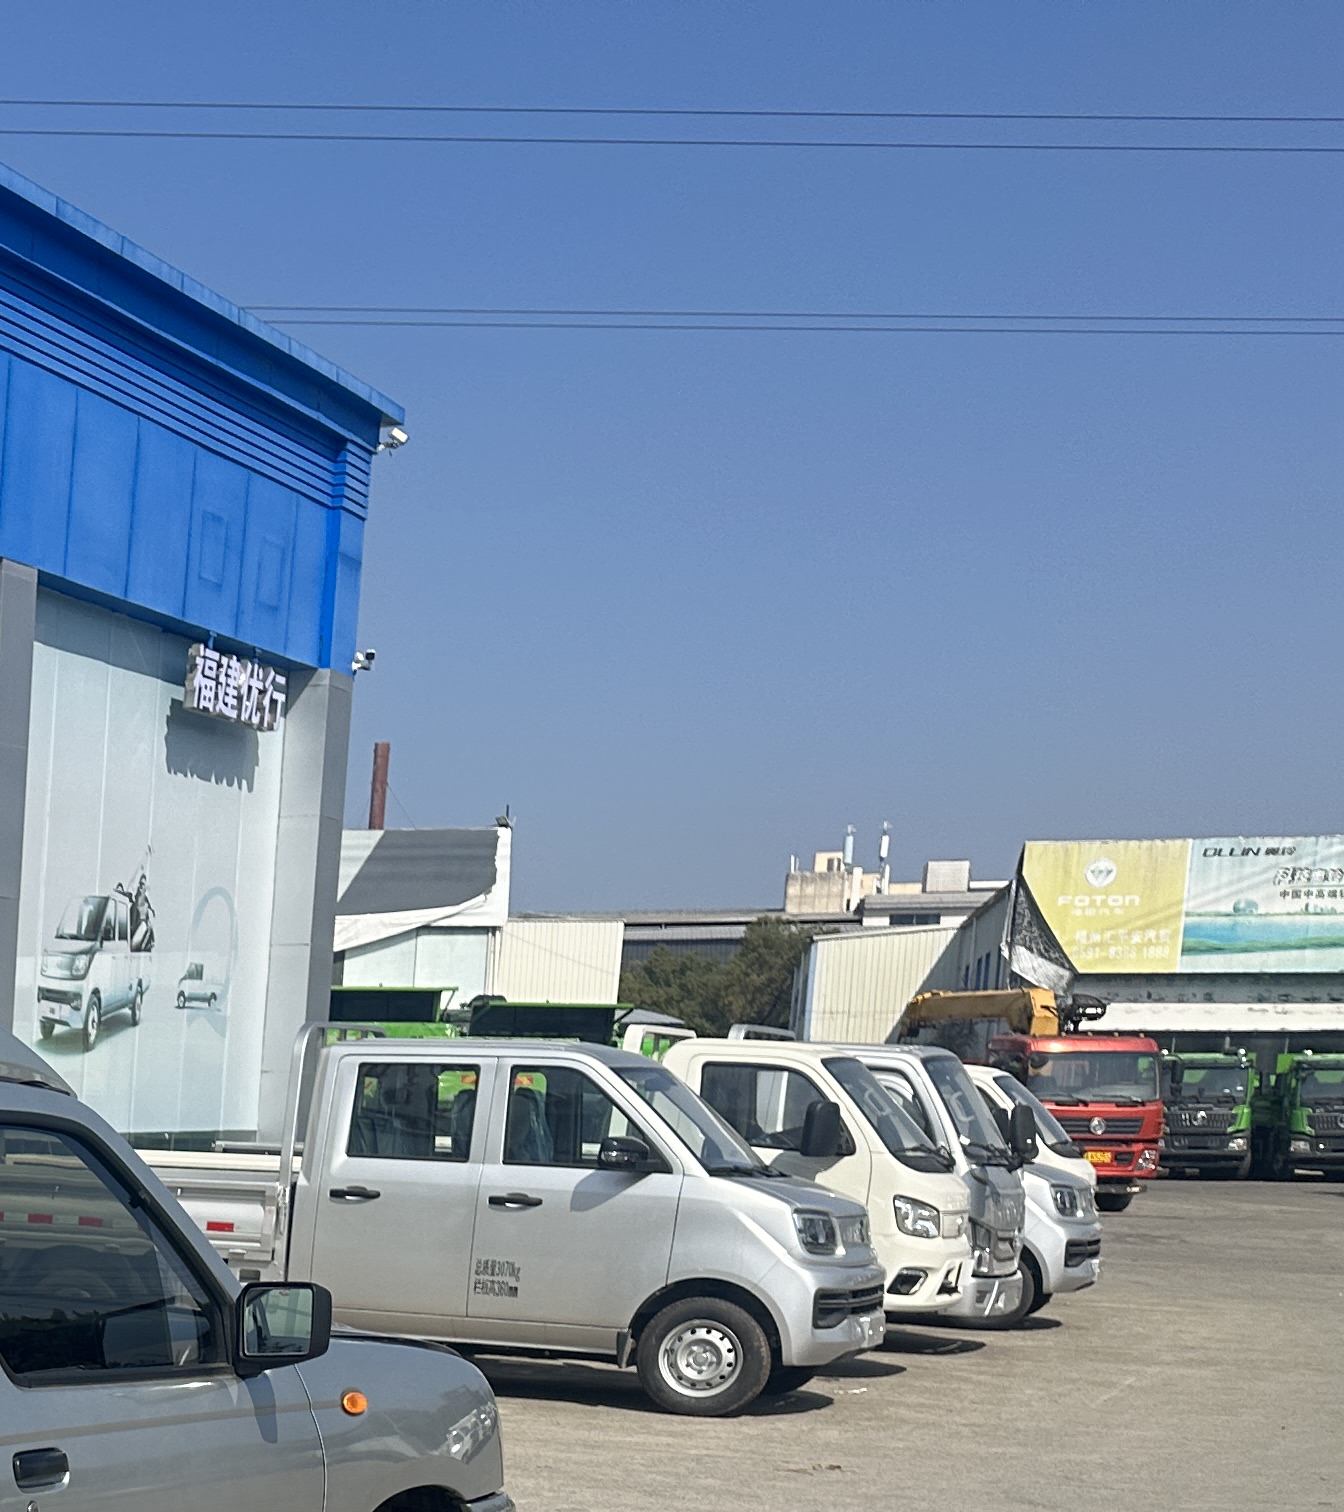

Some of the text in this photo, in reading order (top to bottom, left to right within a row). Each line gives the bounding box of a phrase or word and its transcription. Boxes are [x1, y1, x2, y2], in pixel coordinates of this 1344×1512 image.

[187, 643, 287, 732] 福建优行
[1057, 894, 1141, 907] FOTON
